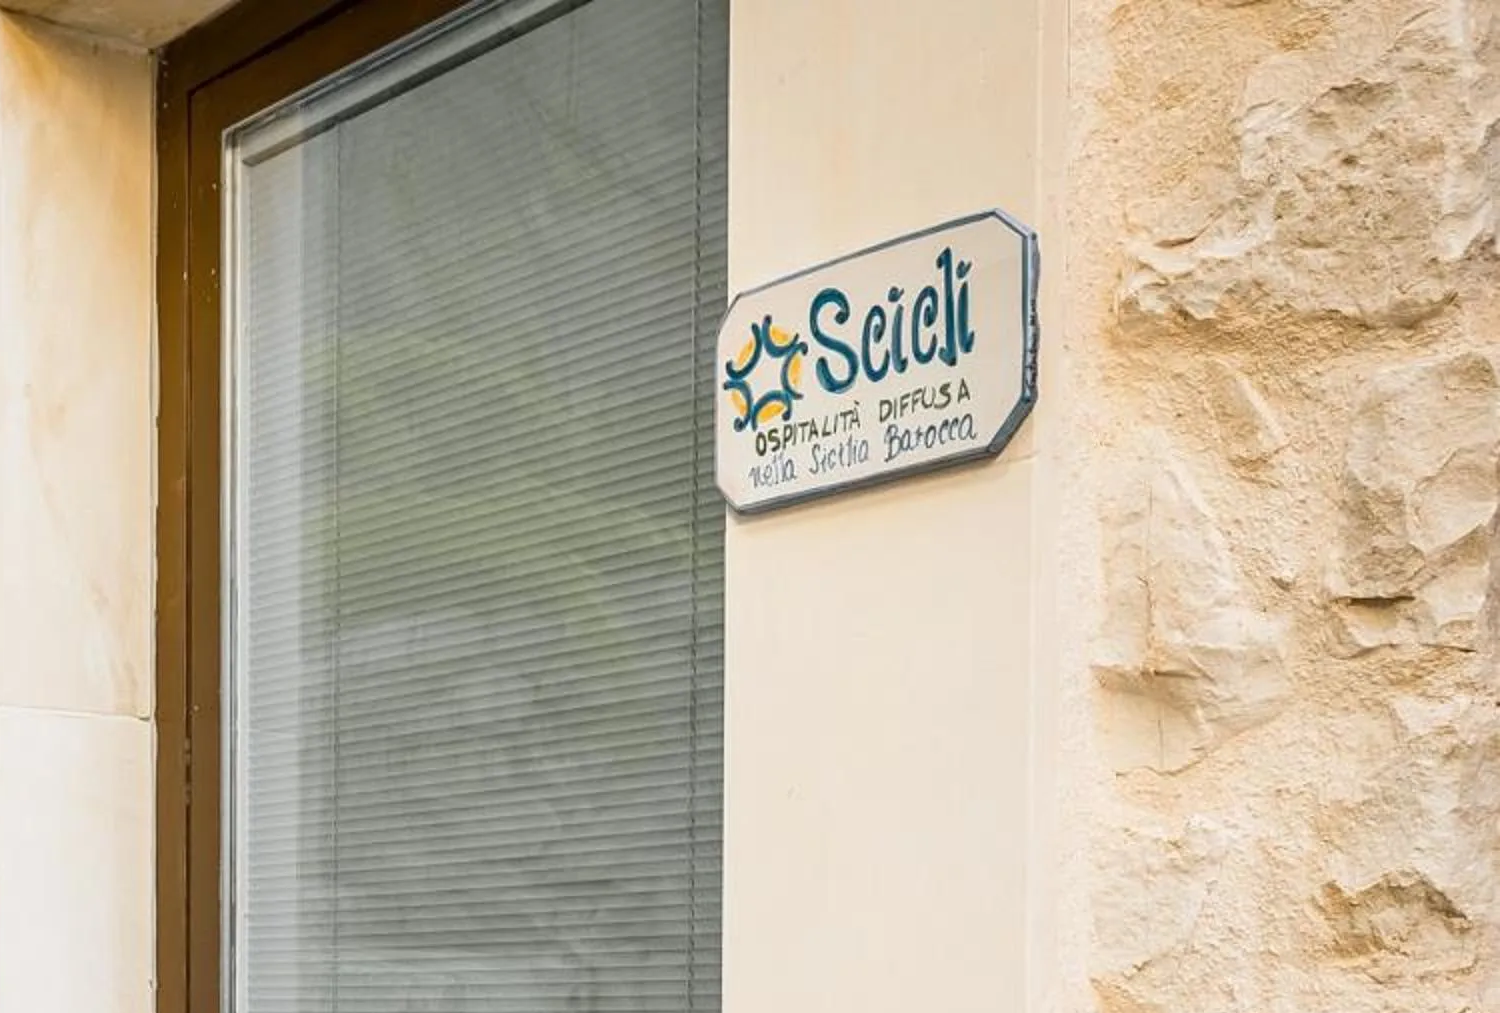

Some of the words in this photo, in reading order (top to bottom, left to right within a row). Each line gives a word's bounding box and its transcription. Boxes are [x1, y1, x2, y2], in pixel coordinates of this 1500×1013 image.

[809, 247, 975, 394] Scicli
[755, 401, 861, 456] OSPITALITÀ
[879, 378, 971, 423] DIFFUSA
[884, 413, 977, 463] Barocca
